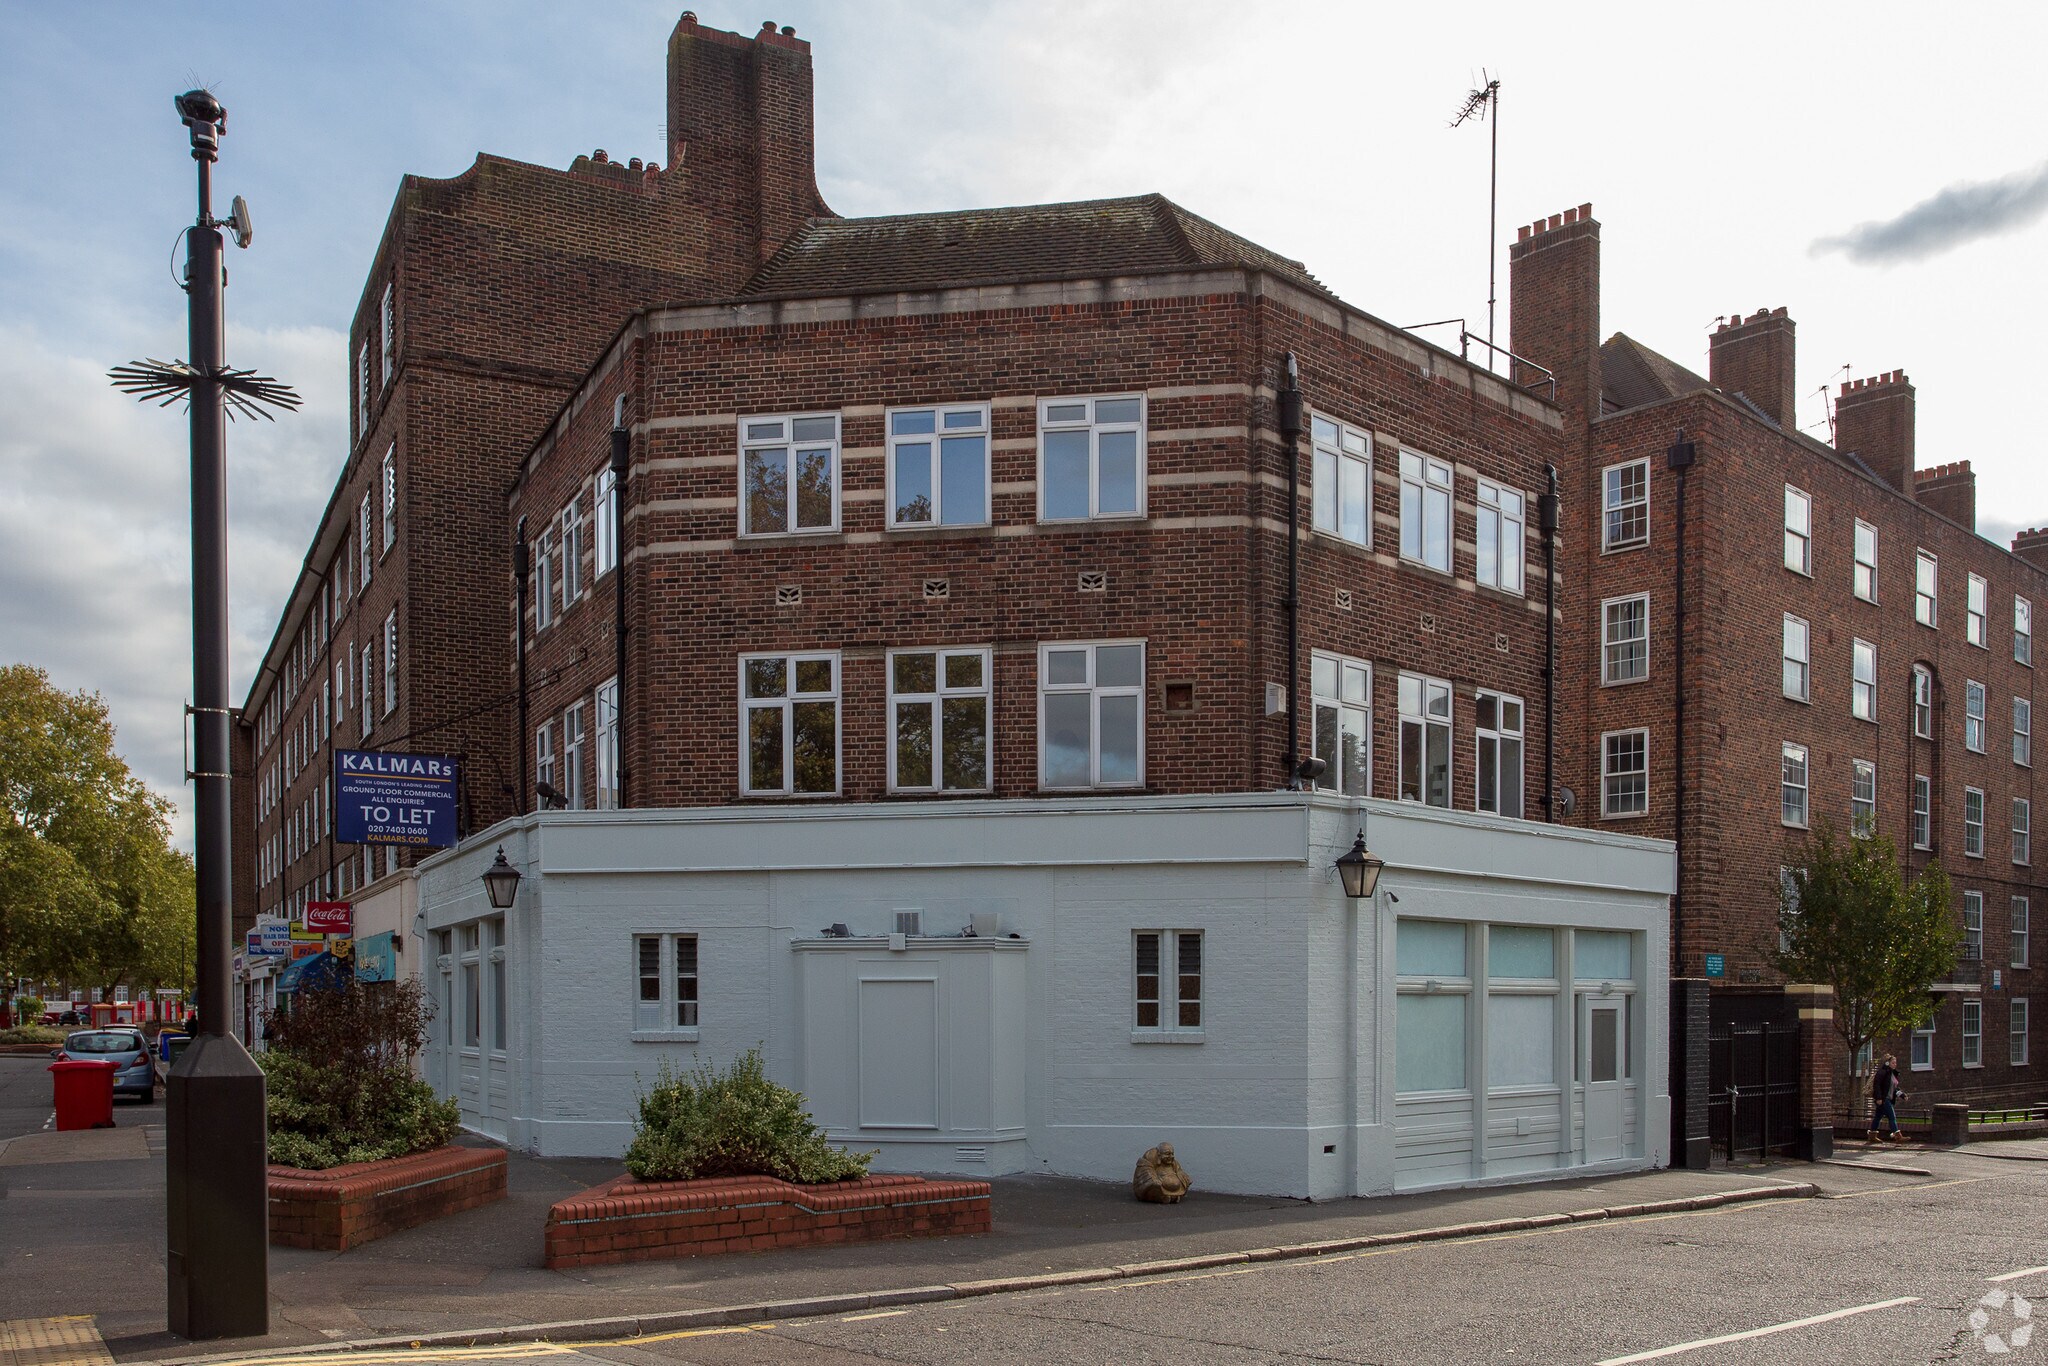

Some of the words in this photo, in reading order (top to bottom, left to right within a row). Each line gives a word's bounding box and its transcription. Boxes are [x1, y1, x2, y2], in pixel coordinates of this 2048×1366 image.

[342, 786, 376, 794] GROUND
[377, 788, 402, 796] FLOOR
[404, 790, 452, 799] COMMERCIAL
[386, 797, 425, 805] ENQUIRIES
[360, 806, 390, 823] TO
[399, 808, 435, 825] LET
[368, 825, 384, 833] 020
[385, 826, 406, 834] 7403
[407, 827, 428, 835] 0600
[367, 834, 429, 844] KALMARS.COM
